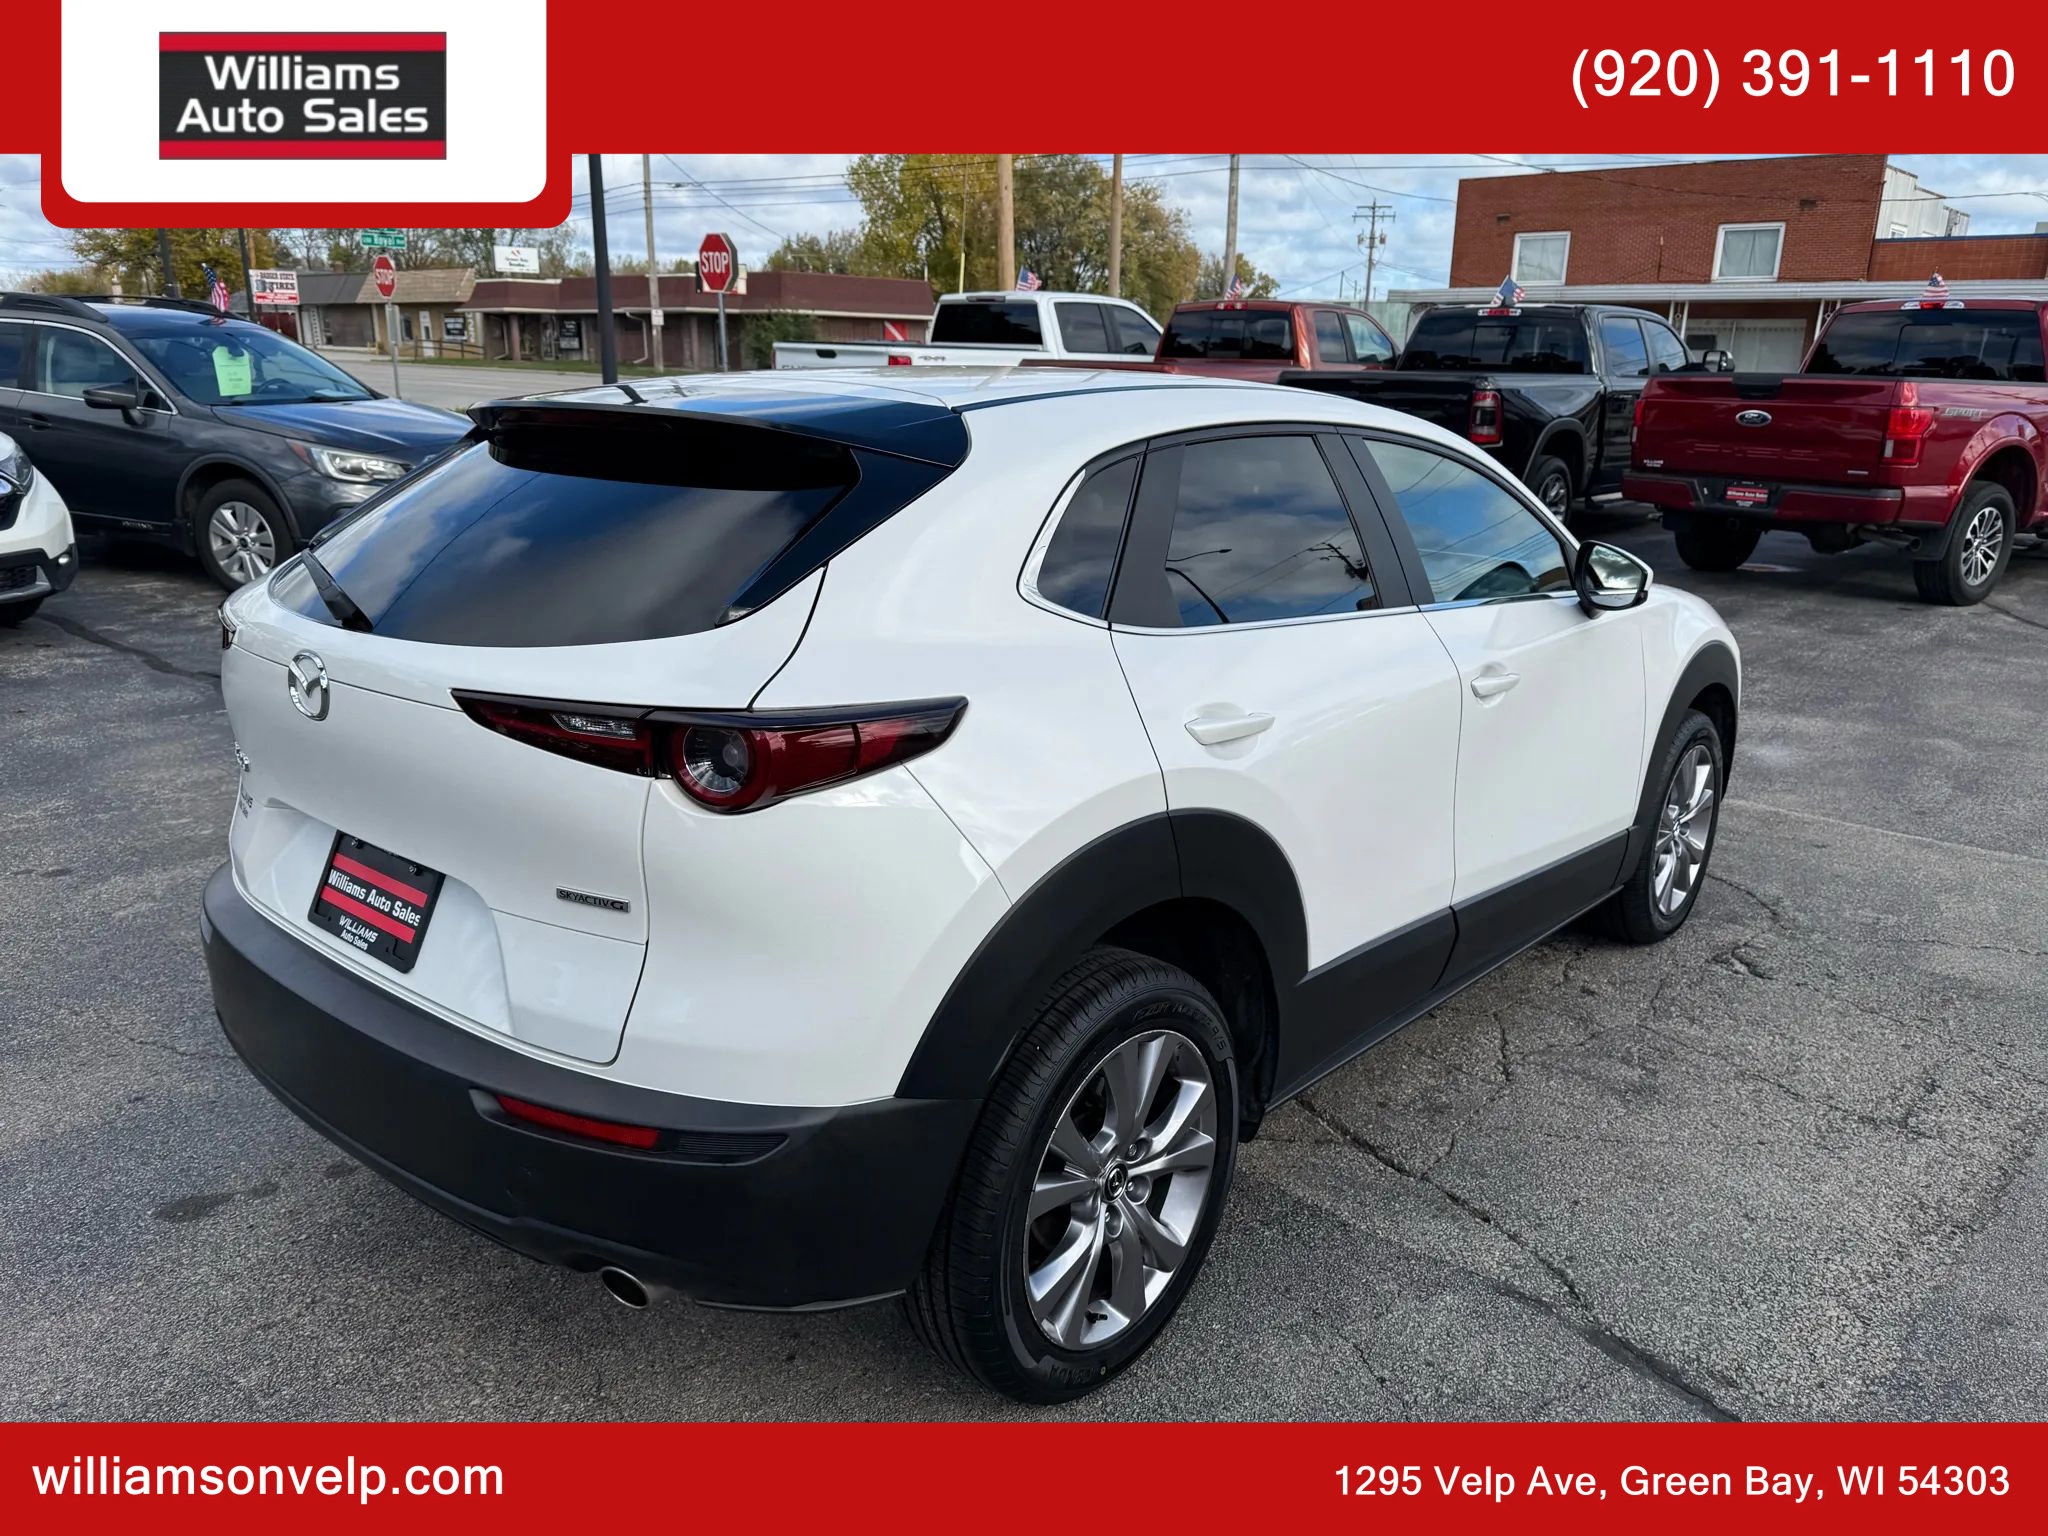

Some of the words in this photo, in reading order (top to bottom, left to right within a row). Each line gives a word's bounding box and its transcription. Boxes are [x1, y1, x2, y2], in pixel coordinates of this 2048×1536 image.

[701, 251, 729, 273] STOP
[375, 268, 393, 285] STOP
[328, 869, 367, 900] Williams
[366, 889, 391, 912] Auto
[392, 901, 421, 927] Sales
[339, 915, 379, 943] WILLIAMS
[340, 929, 354, 944] Auto
[353, 936, 368, 951] Sales
